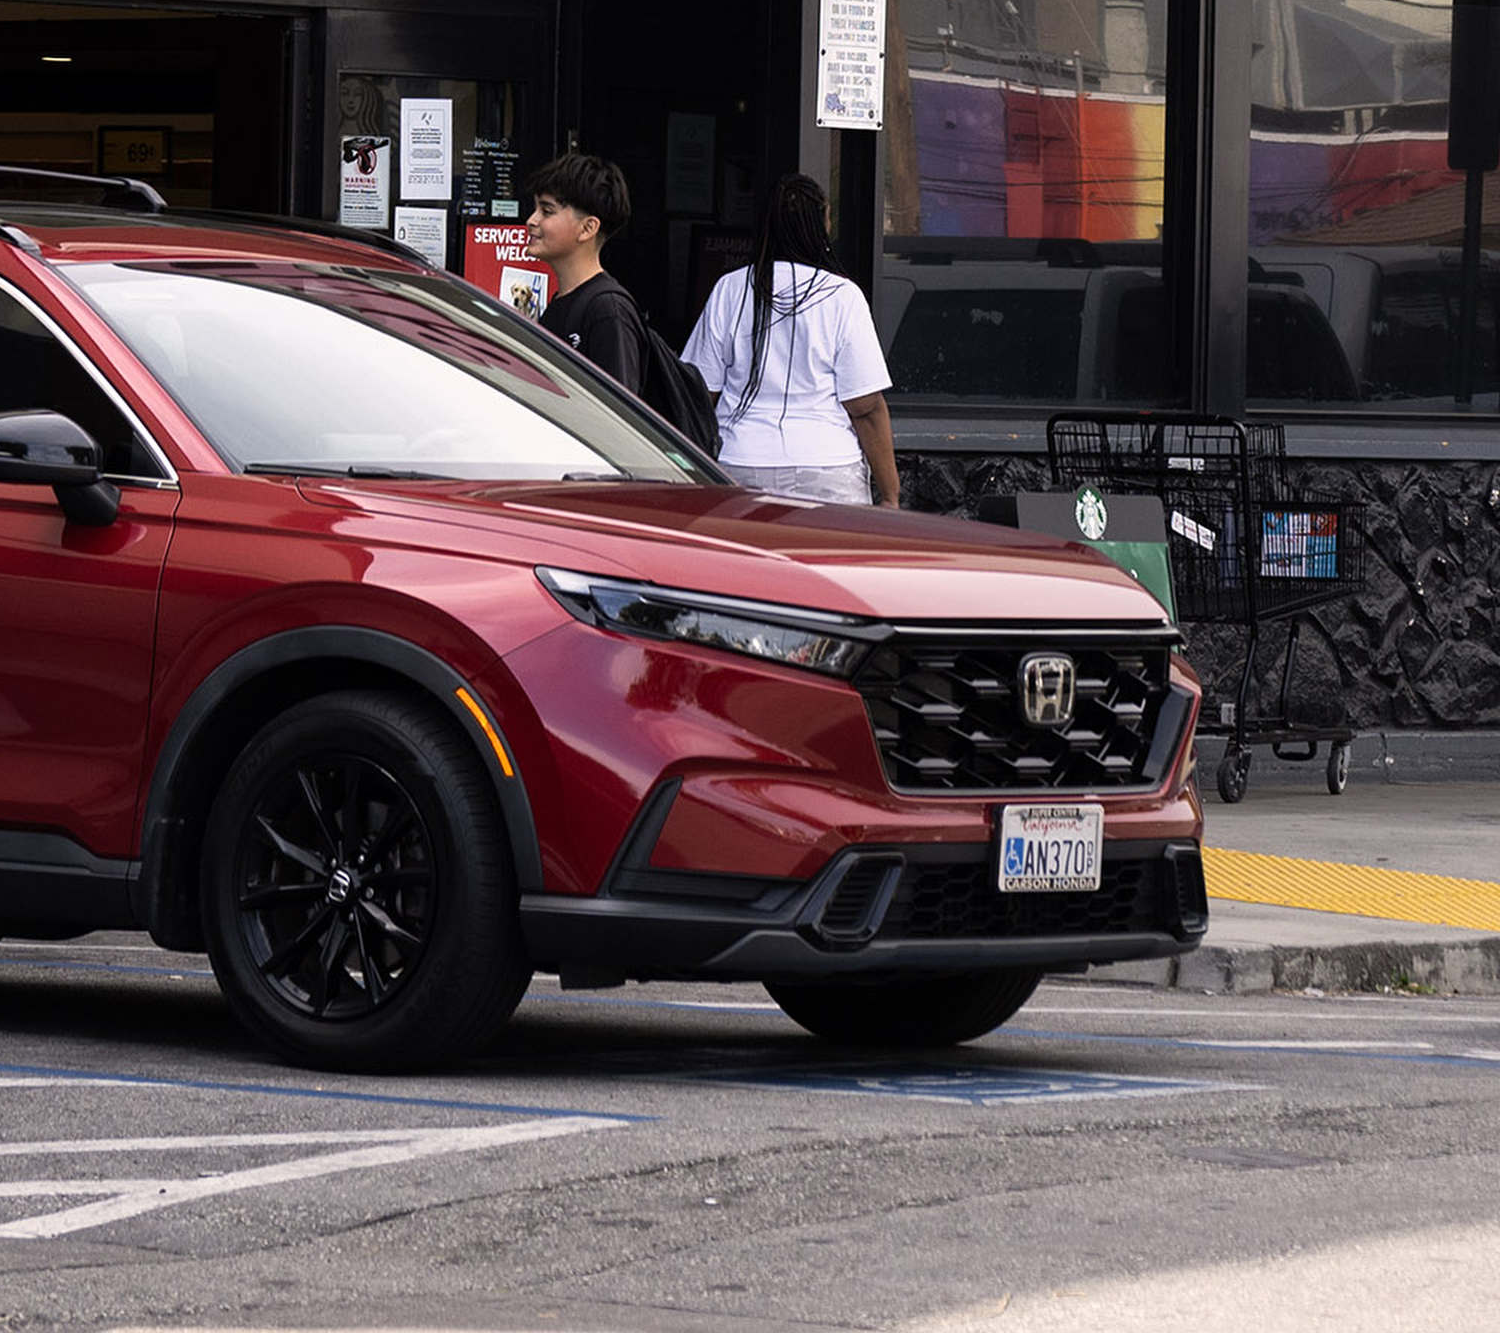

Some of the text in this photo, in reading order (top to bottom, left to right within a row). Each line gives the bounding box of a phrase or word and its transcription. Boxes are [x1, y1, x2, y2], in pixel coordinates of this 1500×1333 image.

[474, 227, 526, 244] SERVICE
[496, 245, 540, 261] WELC
[1024, 840, 1086, 876] AN370
[1005, 877, 1096, 890] CARSON HONDA
